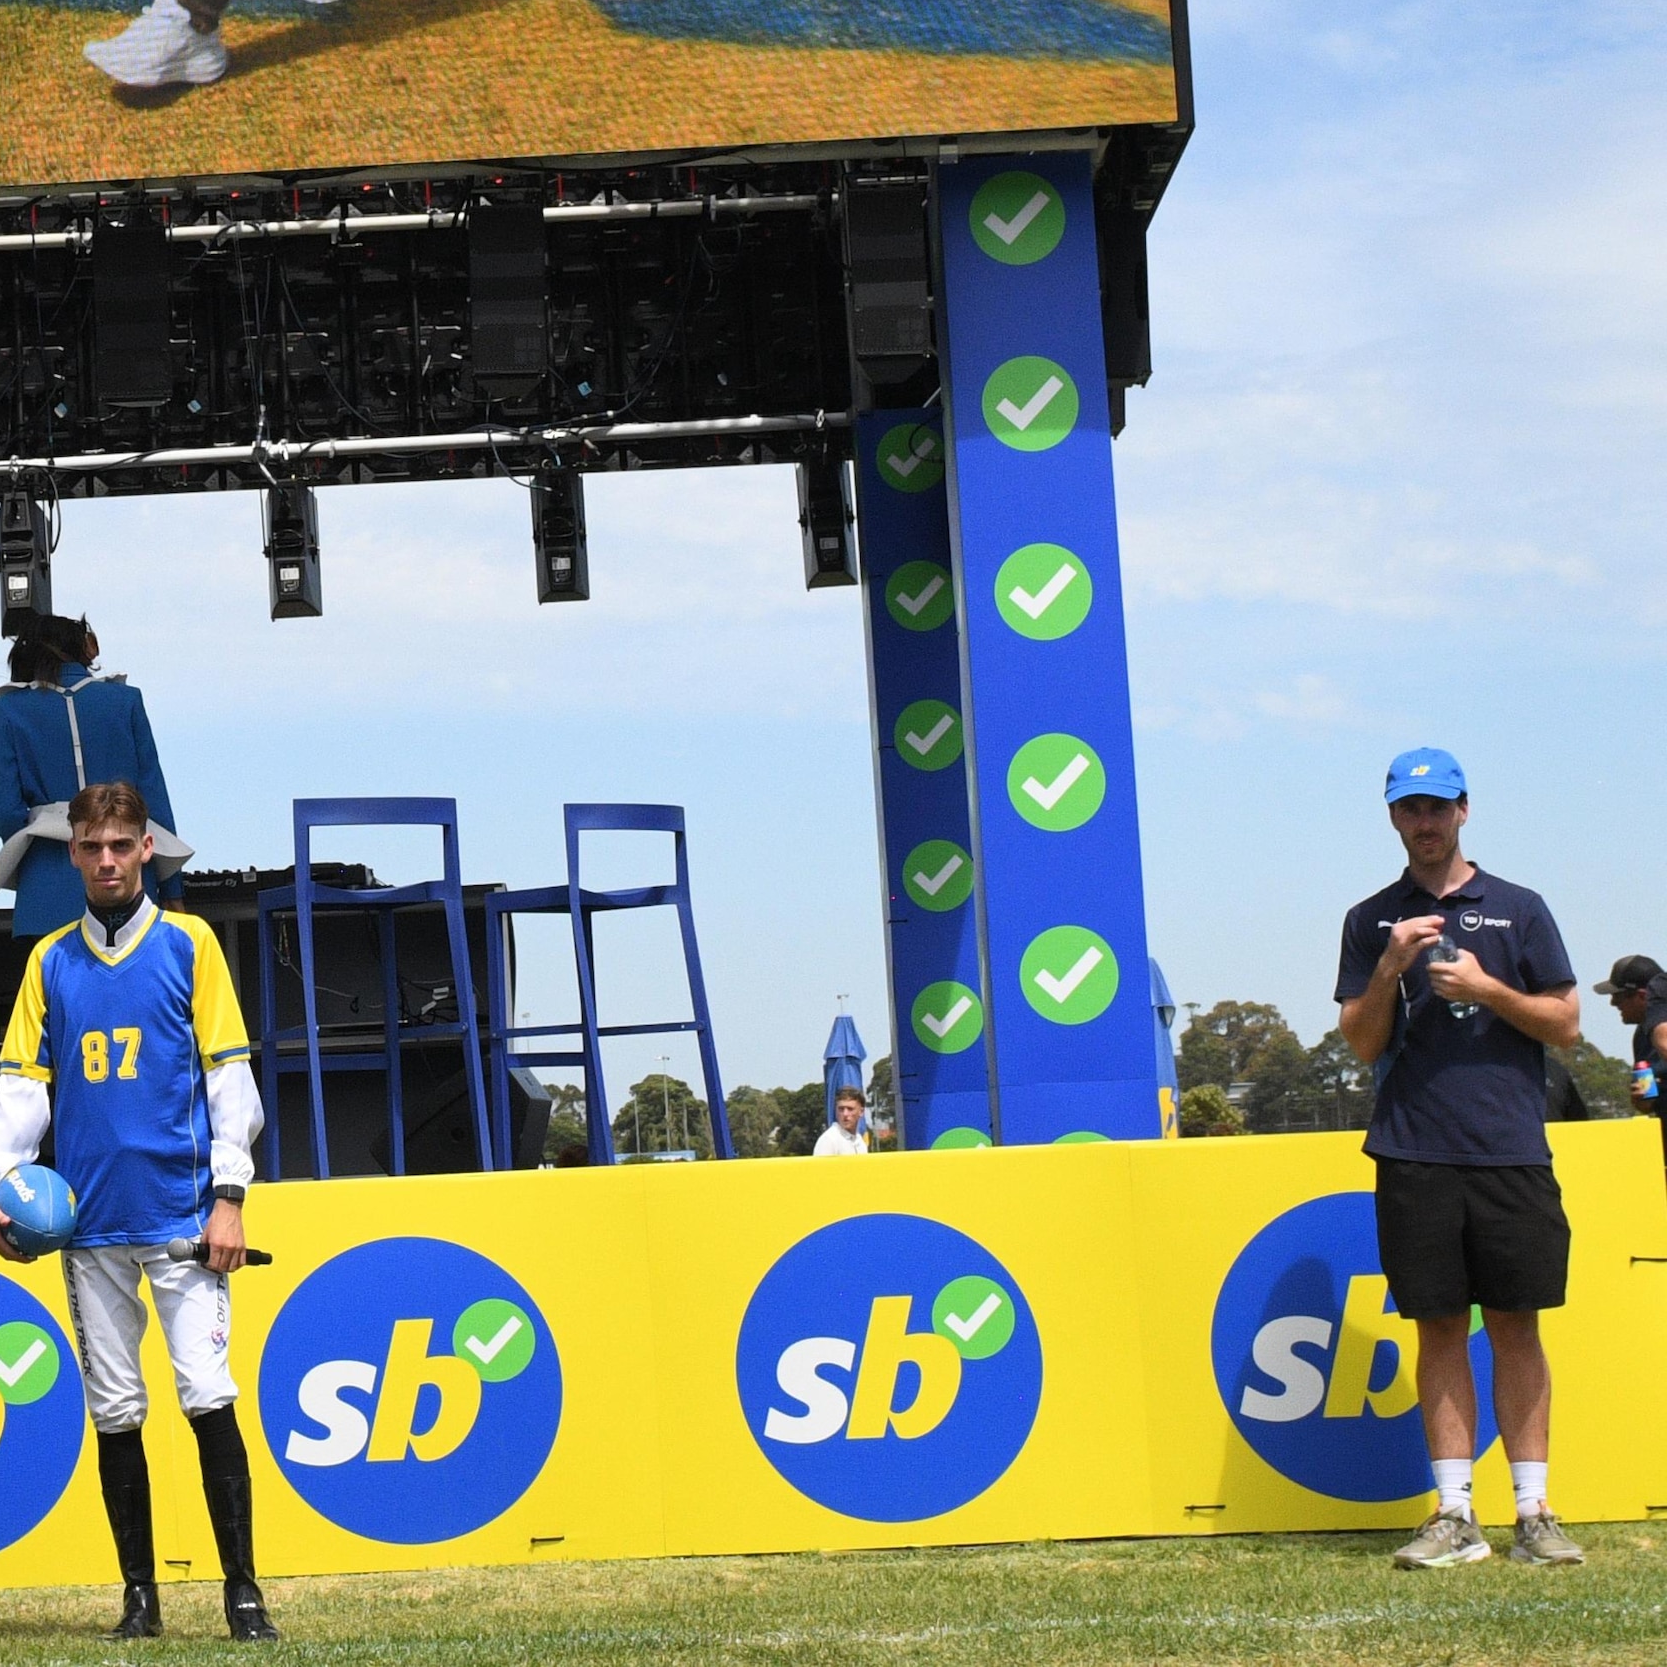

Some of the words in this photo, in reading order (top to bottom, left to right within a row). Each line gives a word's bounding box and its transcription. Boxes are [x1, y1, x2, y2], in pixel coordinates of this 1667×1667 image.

[81, 1027, 142, 1083] 87
[77, 1326, 94, 1377] TRACK
[285, 1318, 483, 1467] sb
[763, 1295, 963, 1445] sb
[1240, 1274, 1419, 1422] sb
